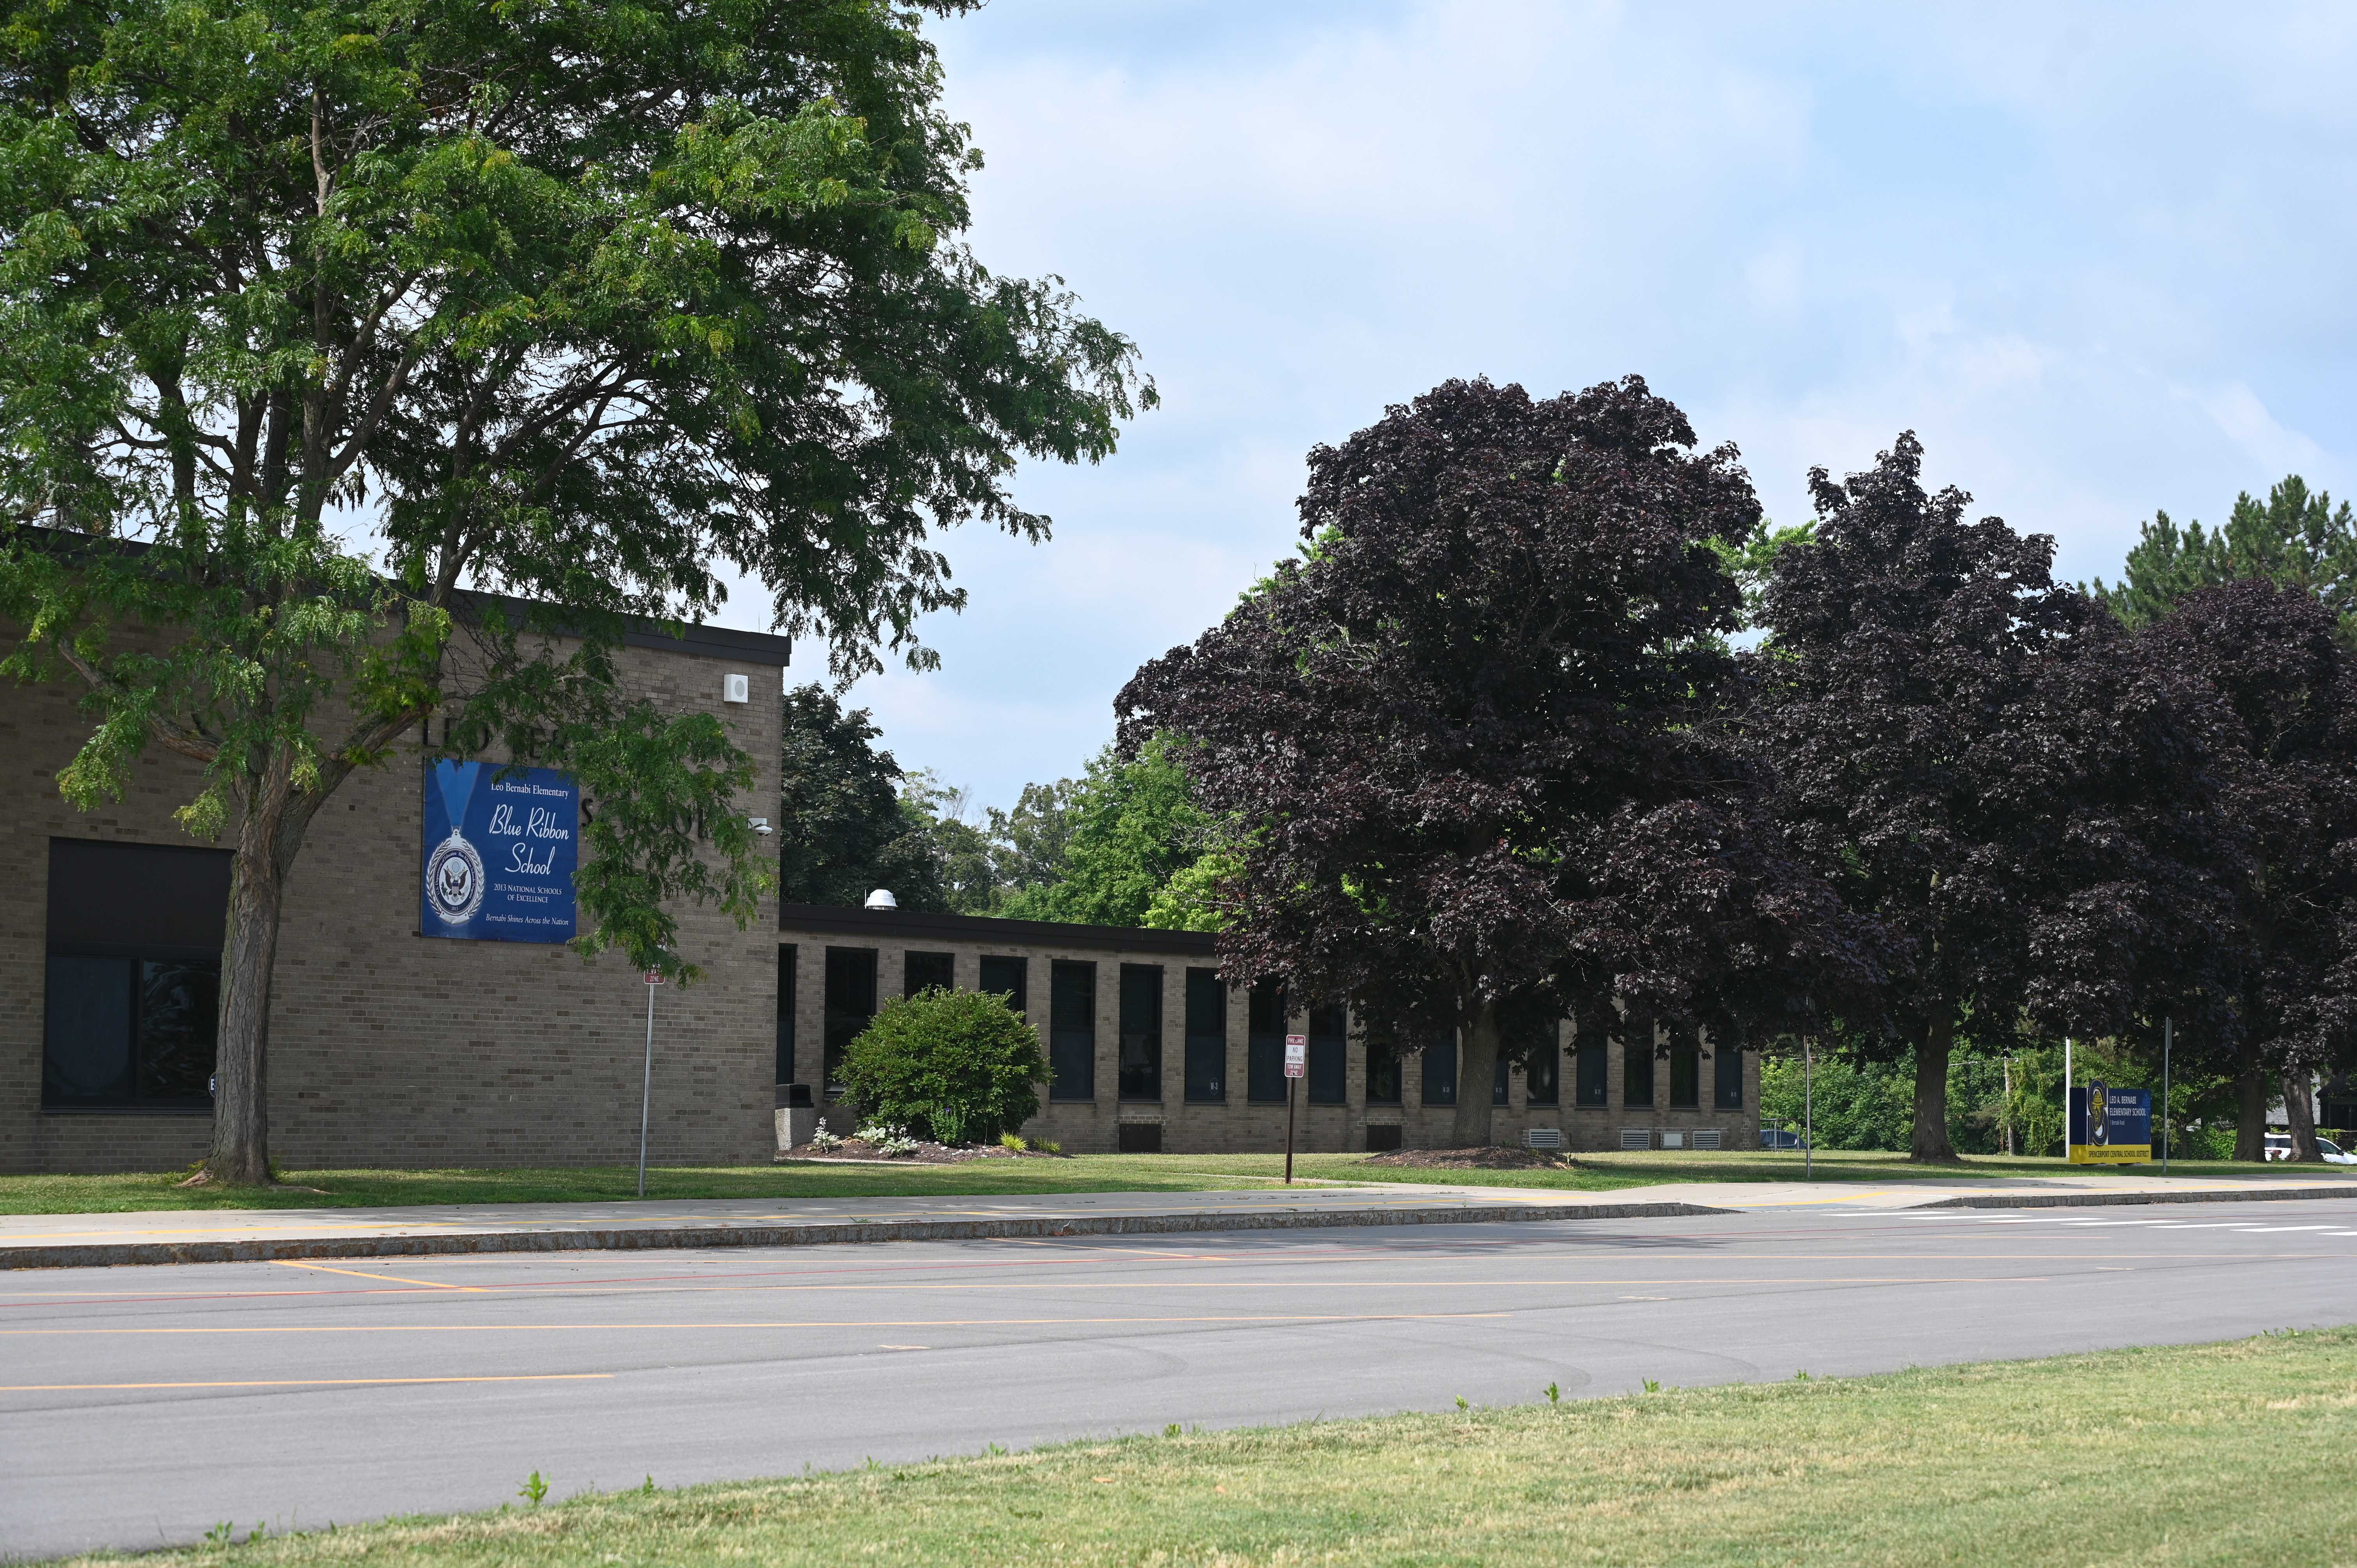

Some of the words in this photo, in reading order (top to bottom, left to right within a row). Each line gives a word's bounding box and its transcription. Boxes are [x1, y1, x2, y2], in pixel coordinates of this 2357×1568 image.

[491, 782, 504, 791] Leo
[506, 782, 530, 794] Bernabi
[533, 785, 569, 799] Elementary
[489, 803, 521, 836] Blue
[526, 807, 569, 840] Ribbon
[505, 842, 555, 875] School
[508, 885, 536, 893] NATIONAL
[537, 886, 562, 895] SCHOOLS
[517, 894, 548, 903] EXCELLENCE
[486, 913, 506, 922] Bernabi
[507, 915, 523, 923] Shines
[551, 917, 569, 925] Nation
[2121, 1096, 2136, 1104] BERNABI
[2110, 1107, 2132, 1116] ELEMENTARY
[2132, 1108, 2146, 1116] SCHOOL
